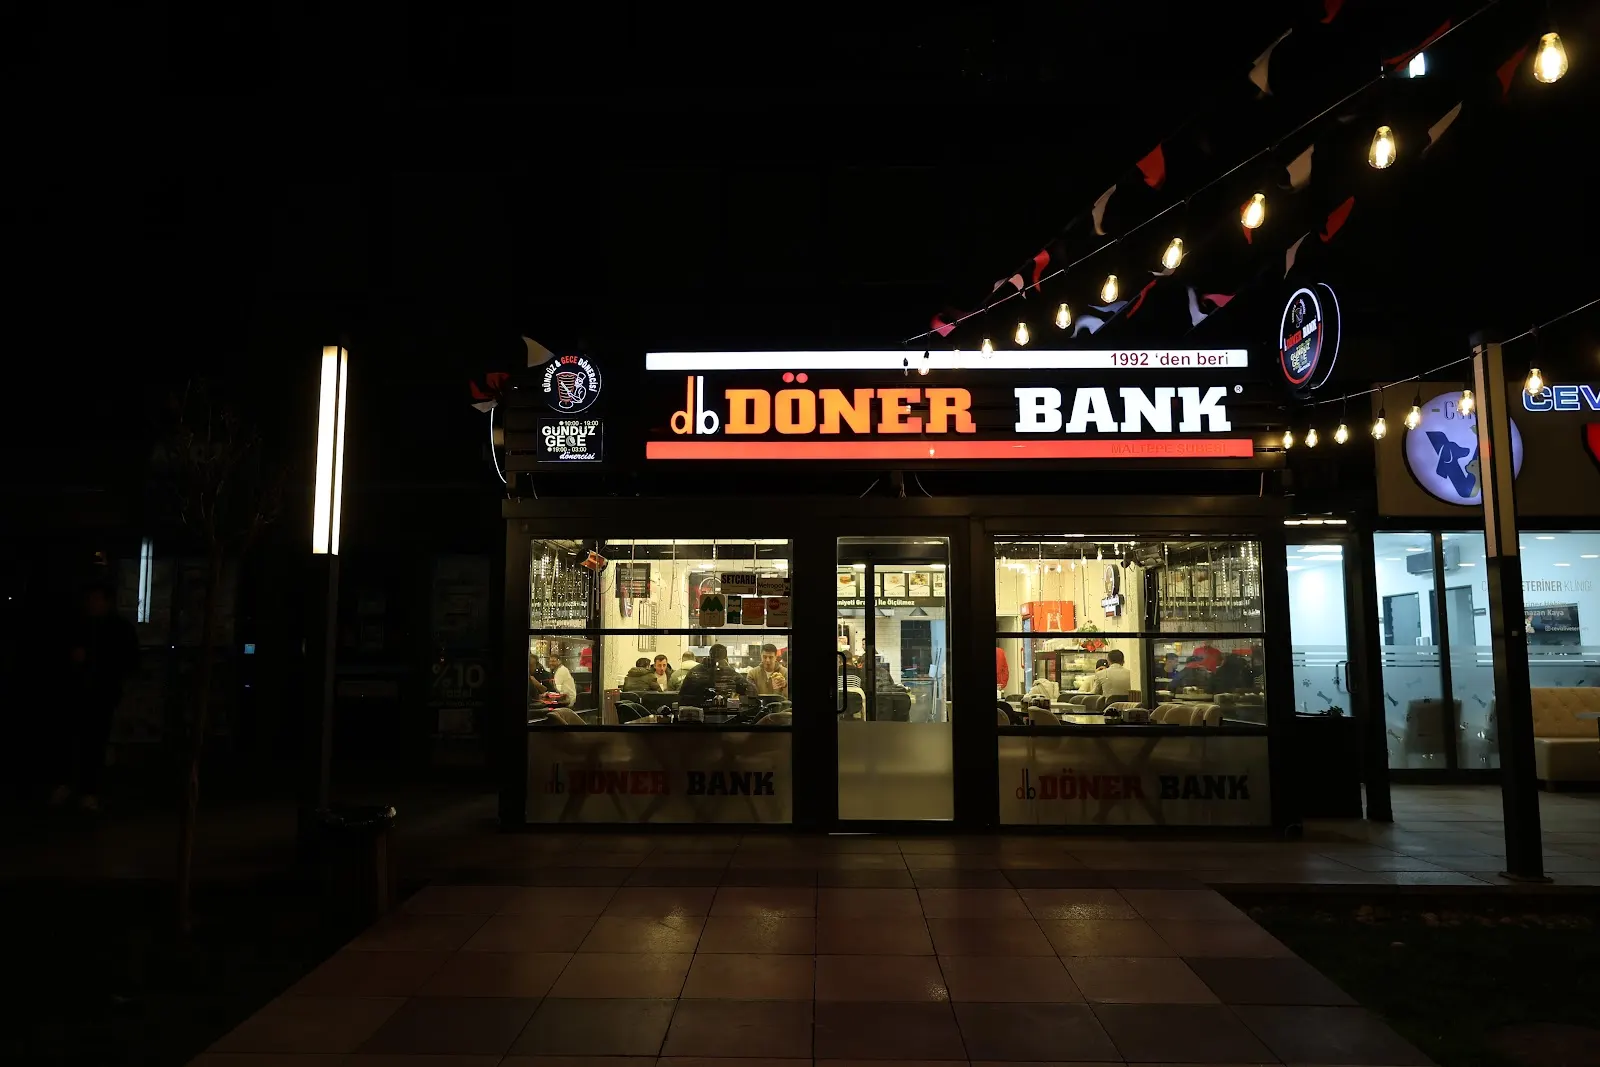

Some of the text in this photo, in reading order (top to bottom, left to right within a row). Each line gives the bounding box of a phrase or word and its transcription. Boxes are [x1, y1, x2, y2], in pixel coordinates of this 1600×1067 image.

[560, 355, 579, 365] GECE
[1110, 352, 1150, 367] 1992
[1196, 352, 1230, 367] beri
[724, 372, 977, 434] DÖNER
[1014, 386, 1233, 433] BANK
[721, 574, 756, 585] SETCARD
[1522, 578, 1562, 592] ETERİNER
[1547, 609, 1564, 617] Kaya
[687, 771, 775, 796] BANK
[1038, 767, 1145, 800] DÖNER
[1158, 775, 1251, 800] BANK
